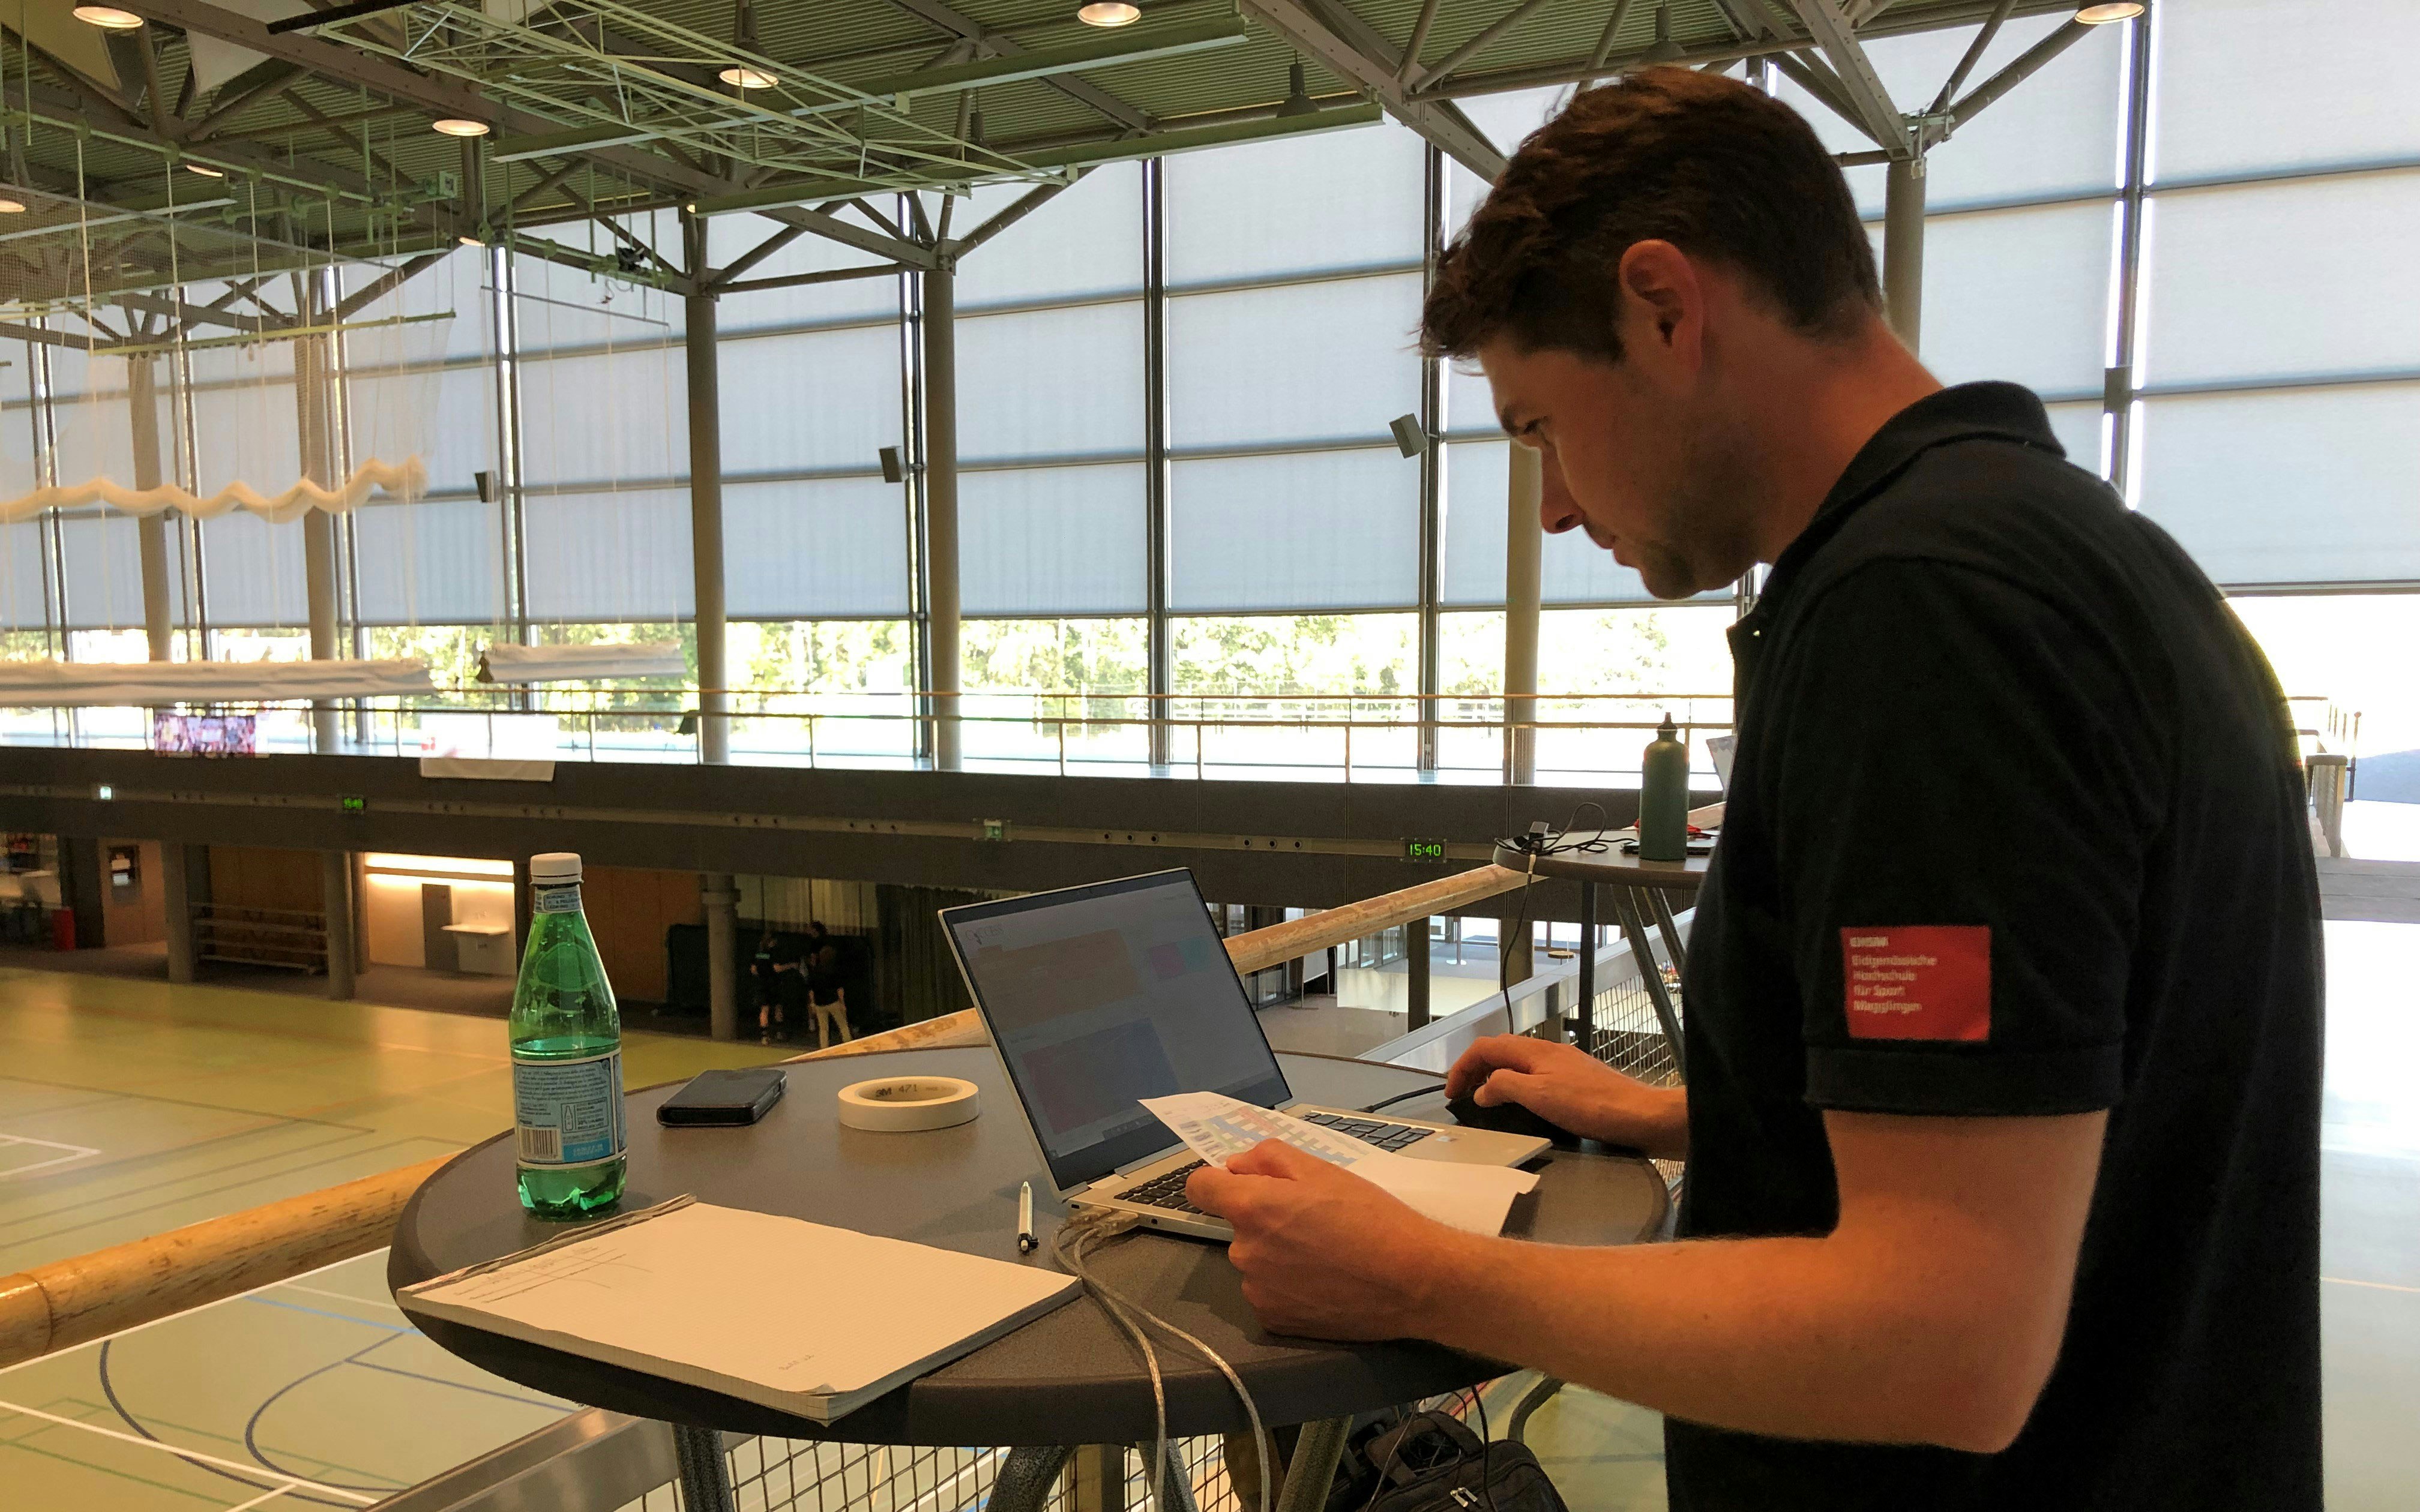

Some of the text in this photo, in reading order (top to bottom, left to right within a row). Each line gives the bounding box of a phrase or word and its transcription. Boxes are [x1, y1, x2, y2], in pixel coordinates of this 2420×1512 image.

[1410, 843, 1441, 857] 15:40
[1873, 985, 1906, 997] Sport
[875, 1087, 892, 1097] 3M
[898, 1084, 918, 1093] 471
